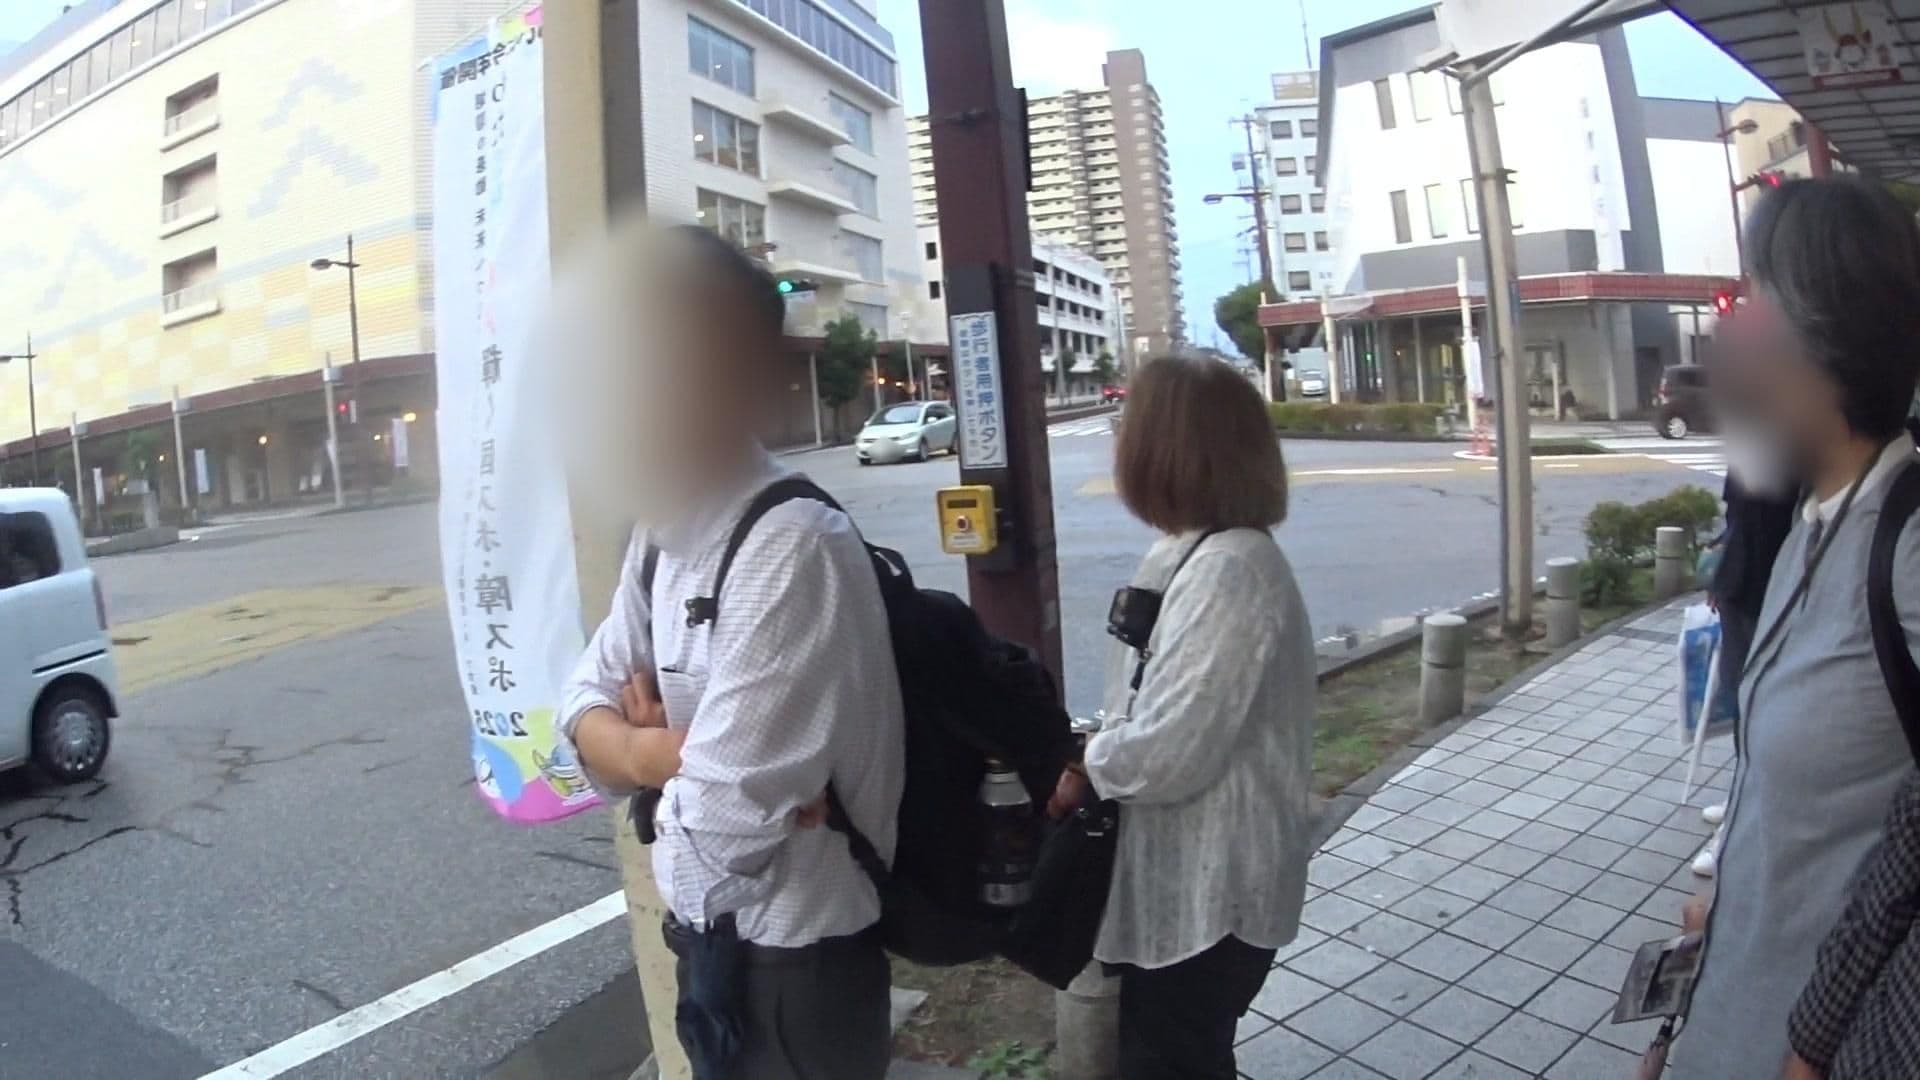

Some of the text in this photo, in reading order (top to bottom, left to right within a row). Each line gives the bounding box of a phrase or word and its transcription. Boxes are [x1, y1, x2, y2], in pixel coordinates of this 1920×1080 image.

[971, 320, 998, 460] 歩行者用押ボタン
